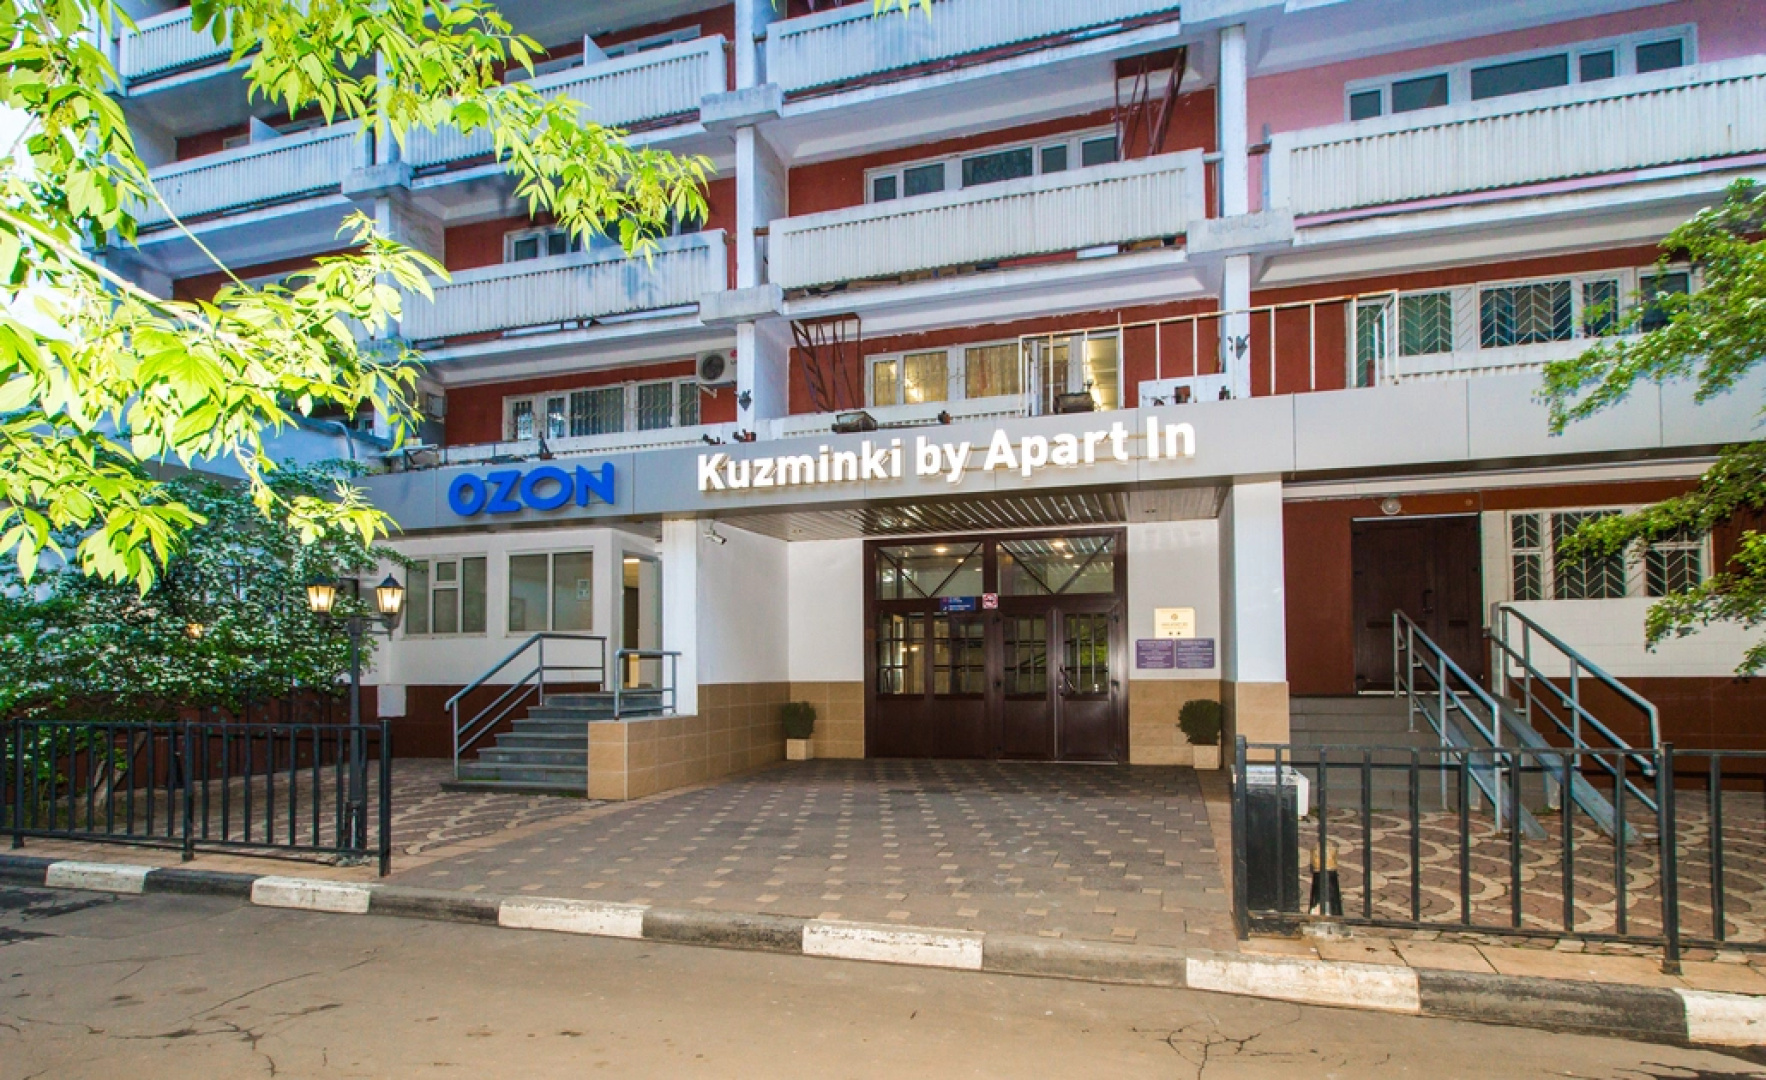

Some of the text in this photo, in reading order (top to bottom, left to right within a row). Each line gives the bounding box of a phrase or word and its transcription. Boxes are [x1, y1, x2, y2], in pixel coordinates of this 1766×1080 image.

[698, 416, 1196, 491] Kuzminki by Apart In
[448, 461, 615, 517] OZON
